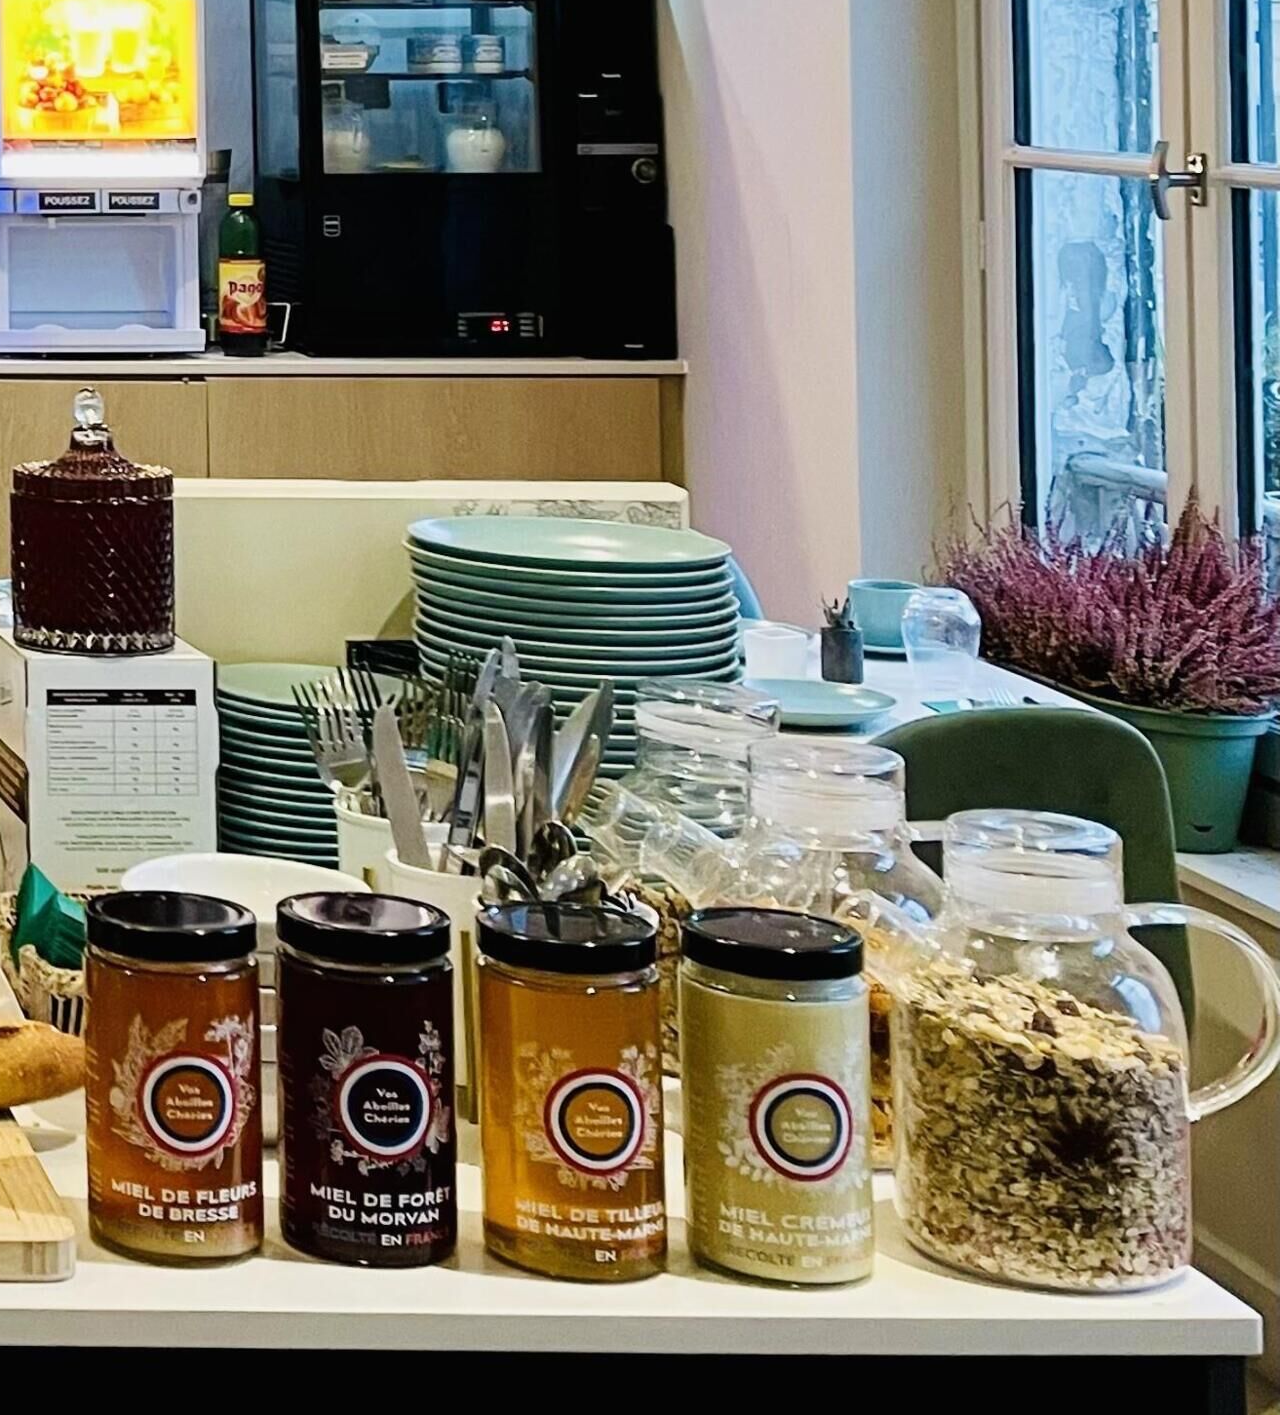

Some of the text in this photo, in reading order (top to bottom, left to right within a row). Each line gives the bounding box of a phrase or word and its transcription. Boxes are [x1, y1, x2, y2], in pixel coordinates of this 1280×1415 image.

[44, 195, 90, 206] POUSSEZ
[111, 195, 156, 206] POUSSEZ
[376, 1087, 399, 1099] Vos
[362, 1100, 411, 1112] Abeilles
[111, 1179, 257, 1205] MIEL DE FLEURS
[310, 1183, 451, 1209] MIEL DE FORÊT
[138, 1203, 239, 1223] DE BRESSE
[328, 1205, 440, 1226] DU MORVAN
[515, 1199, 562, 1220] MIEL
[570, 1207, 600, 1224] DE
[720, 1202, 775, 1227] MIEL
[516, 1214, 540, 1235] DE
[719, 1219, 743, 1236] DE
[184, 1230, 205, 1243] EN
[381, 1233, 403, 1246] EN
[595, 1250, 617, 1263] EN
